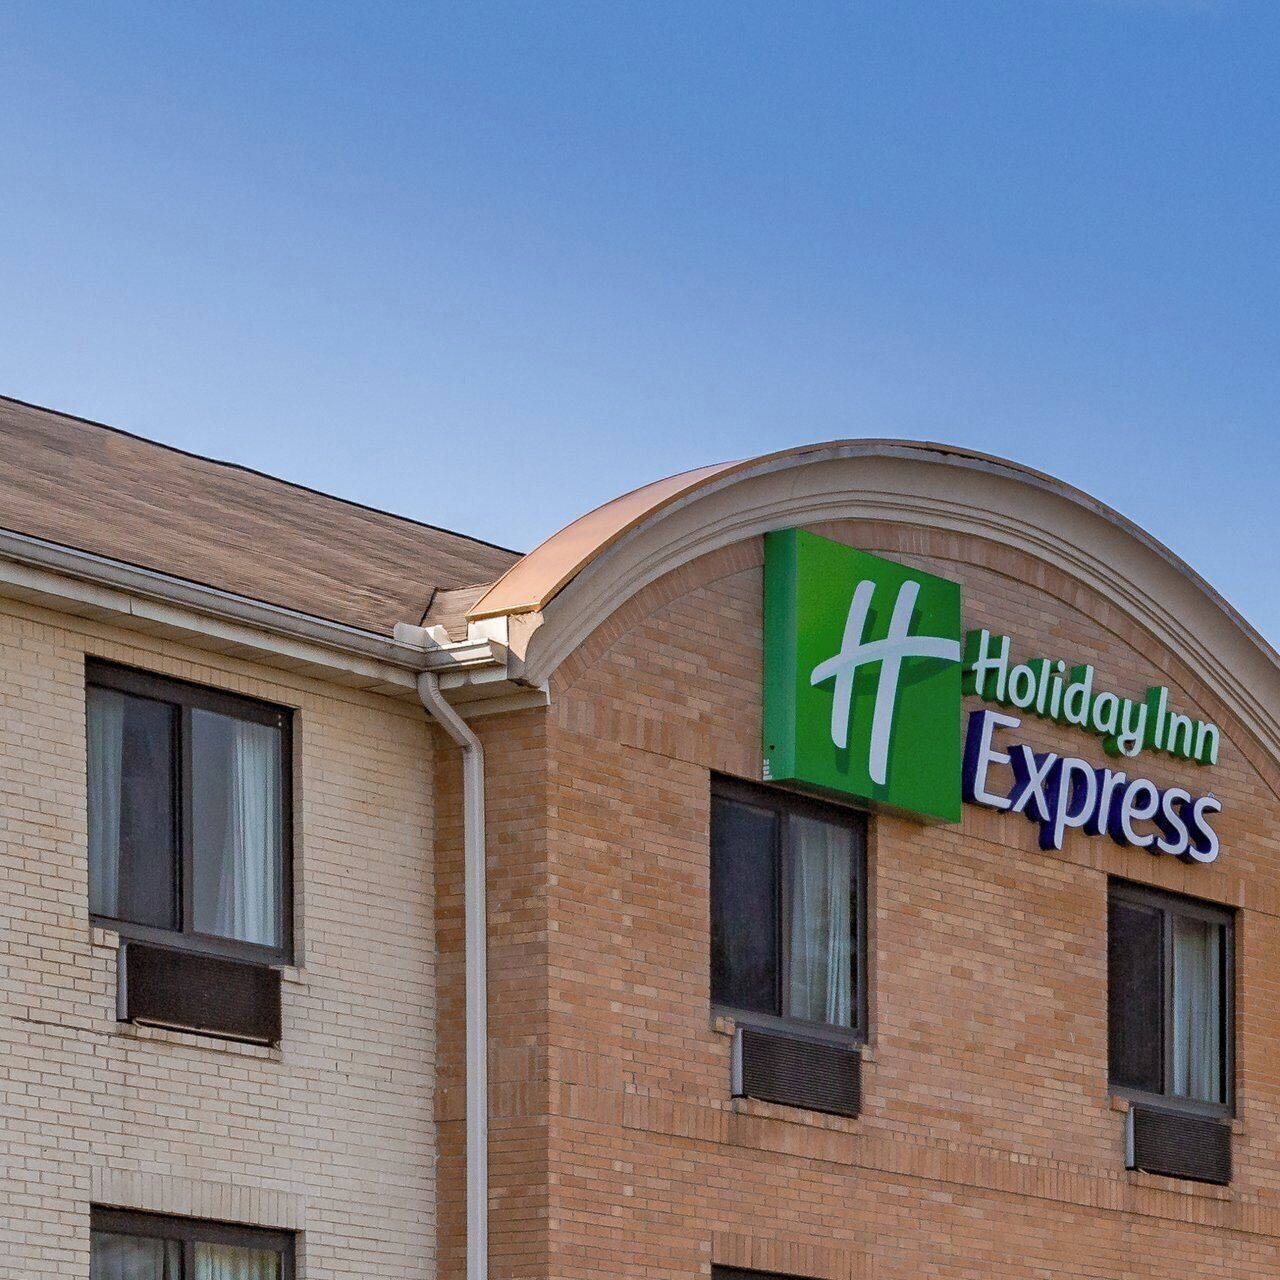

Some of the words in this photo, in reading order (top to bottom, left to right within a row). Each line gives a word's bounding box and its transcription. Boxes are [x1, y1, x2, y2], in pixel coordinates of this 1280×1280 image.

[971, 628, 1148, 757] Holiday
[1155, 686, 1220, 765] Inn
[973, 709, 1222, 863] Express
